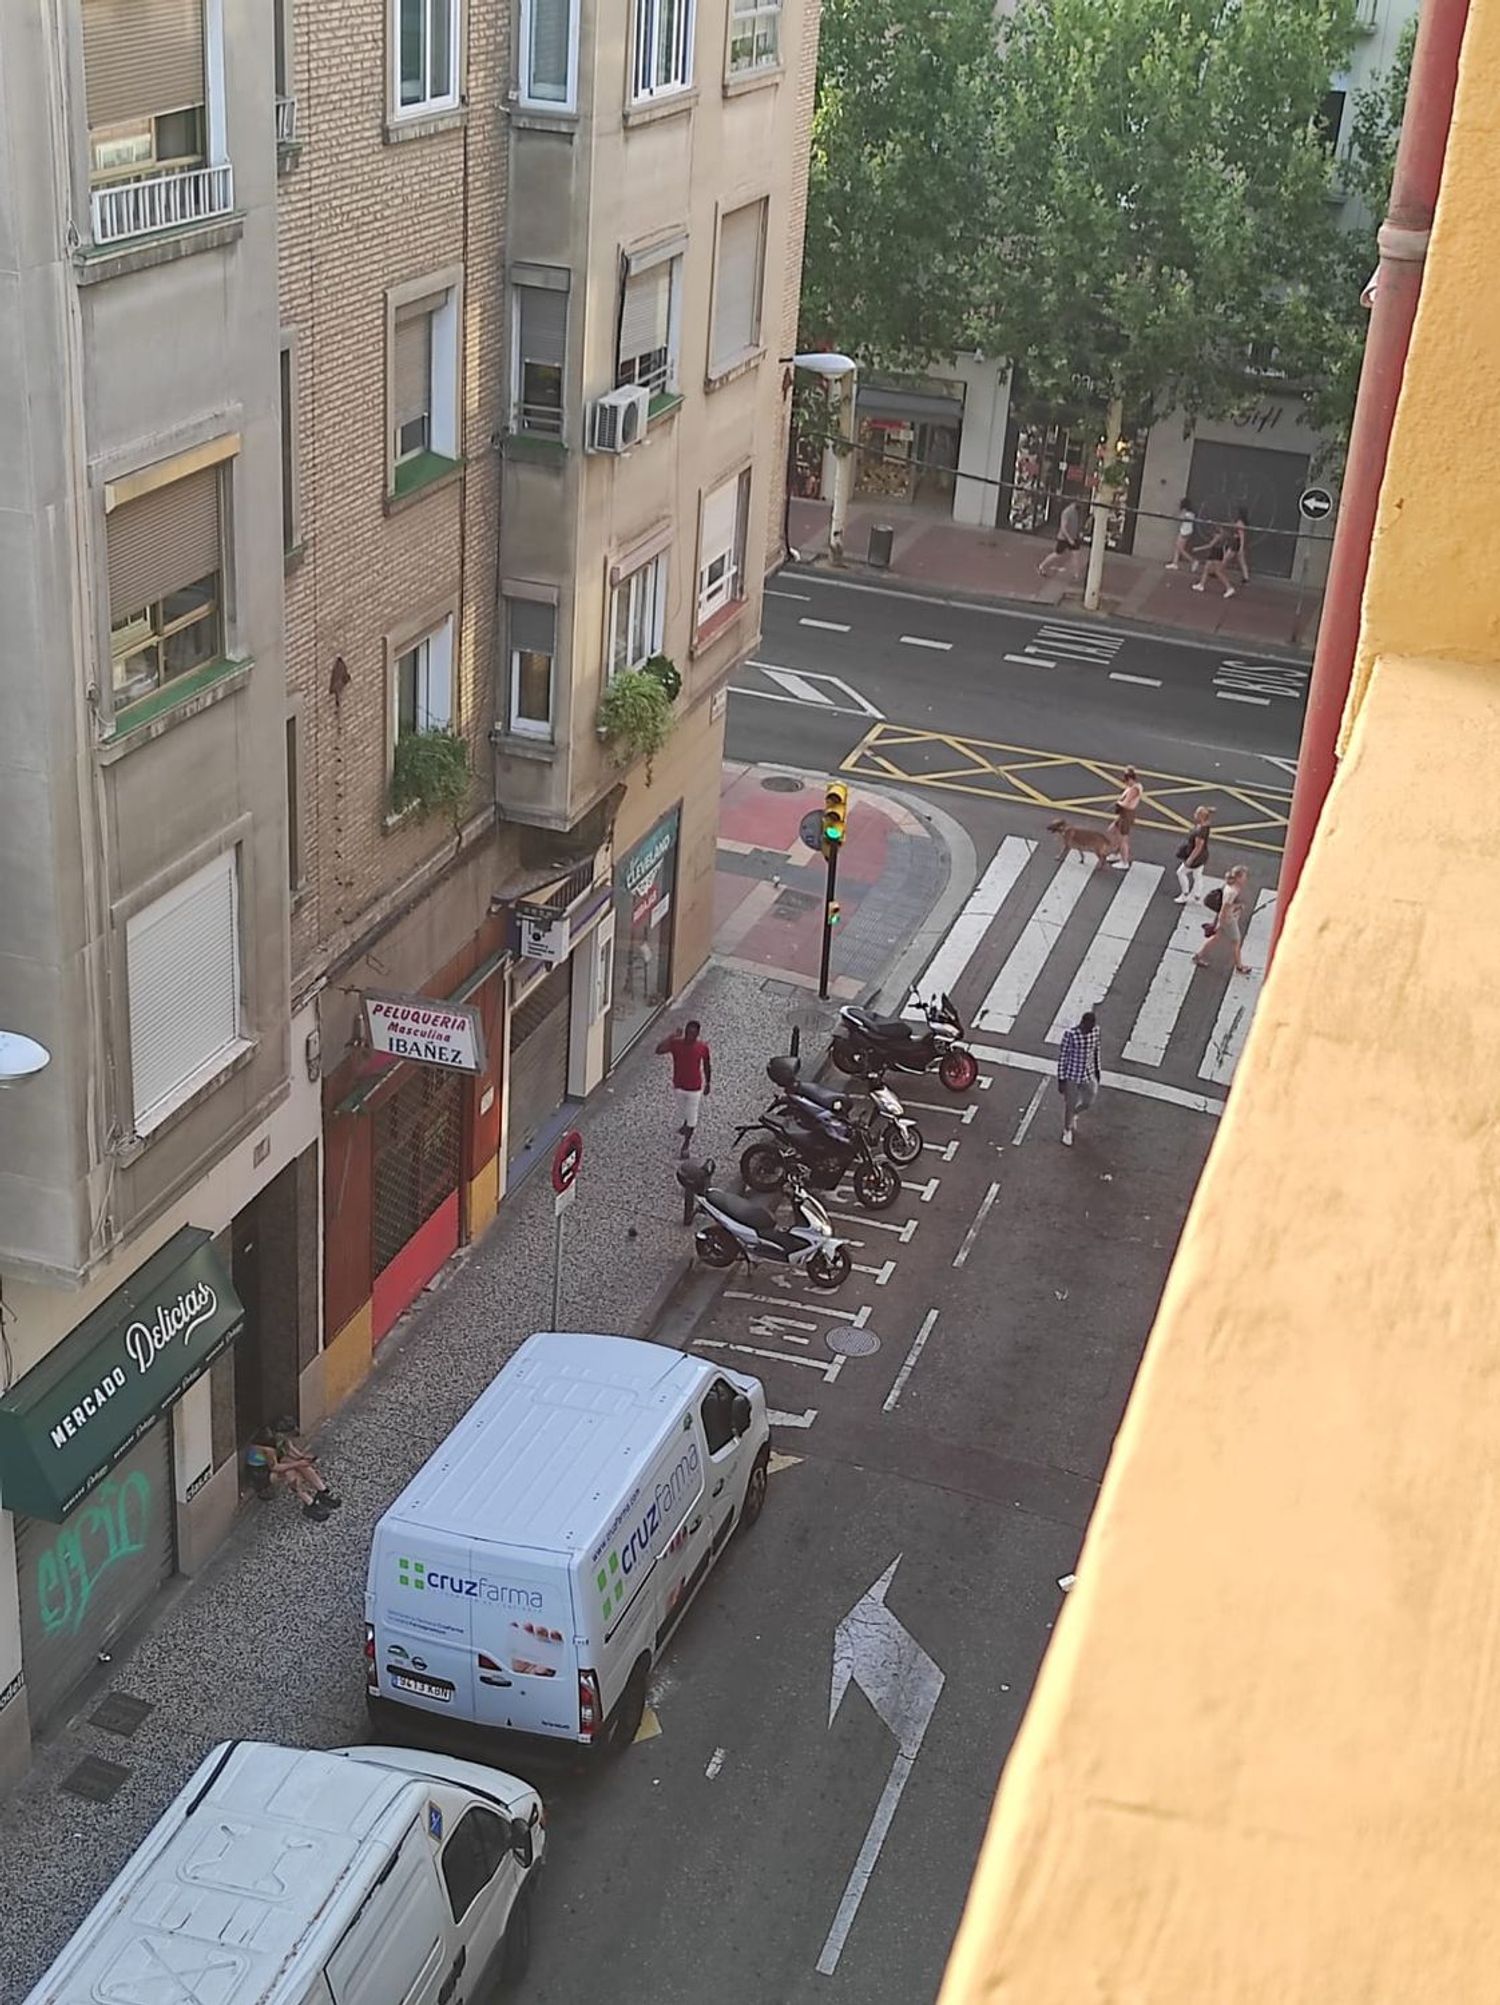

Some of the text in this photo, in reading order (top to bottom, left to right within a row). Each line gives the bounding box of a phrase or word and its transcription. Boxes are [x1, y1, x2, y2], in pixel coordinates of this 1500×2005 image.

[1024, 624, 1125, 664] TAXI
[1212, 659, 1308, 698] BUS
[372, 1003, 467, 1032] PELUQUERIA
[387, 1021, 452, 1043] Masculina
[388, 1036, 463, 1064] IBAÑEZ
[50, 1366, 126, 1449] MERCADO
[126, 1282, 217, 1373] Delicias
[621, 1443, 699, 1575] cruzfarma
[427, 1572, 543, 1608] cruzfarma
